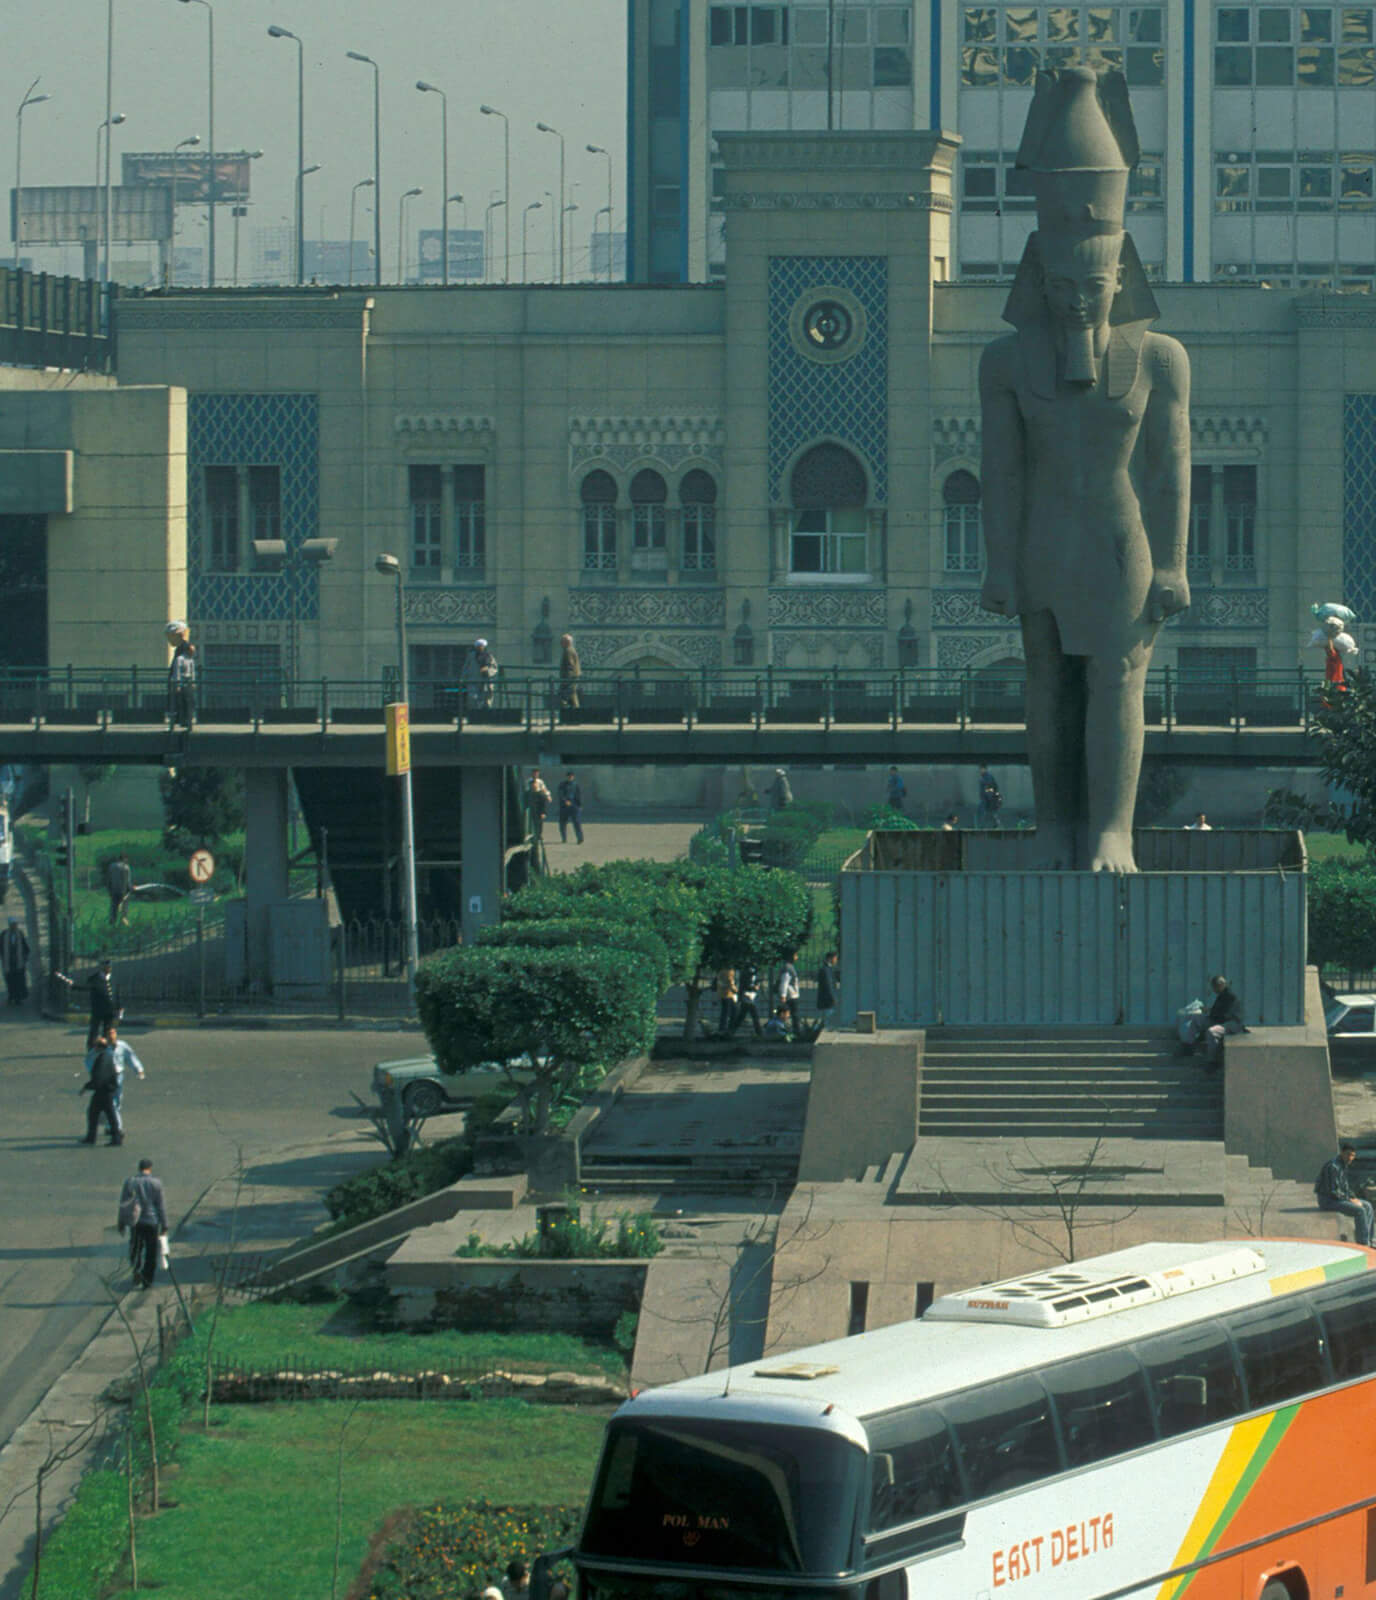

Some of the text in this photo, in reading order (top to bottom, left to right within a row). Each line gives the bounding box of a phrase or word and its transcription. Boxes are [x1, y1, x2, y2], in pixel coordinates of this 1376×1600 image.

[662, 1513, 729, 1529] POL MAN
[993, 1512, 1114, 1588] EAST DELTA
